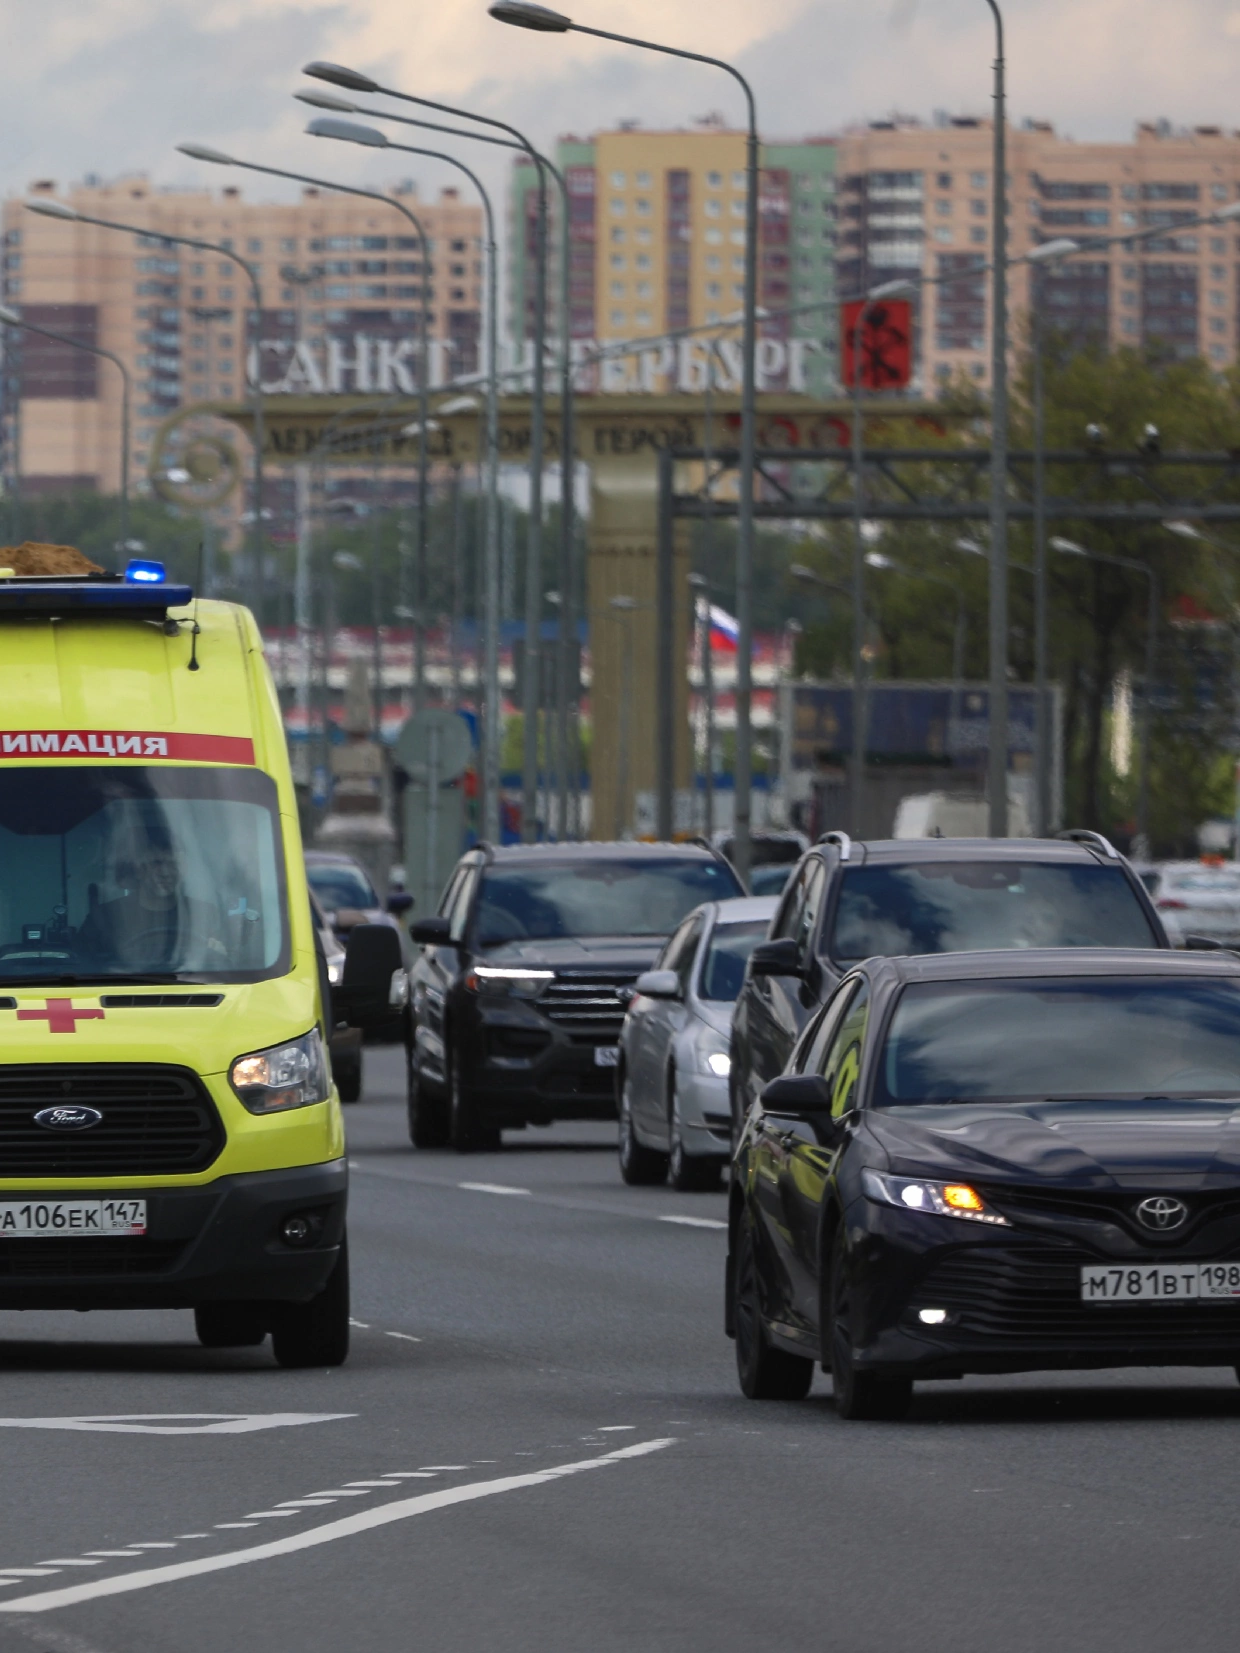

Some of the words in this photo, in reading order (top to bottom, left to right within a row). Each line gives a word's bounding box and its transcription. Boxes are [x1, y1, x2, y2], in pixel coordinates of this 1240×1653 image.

[49, 1108, 87, 1126] Ford
[104, 1202, 140, 1221] 147
[111, 1220, 131, 1228] RUS
[1201, 1266, 1240, 1287] 198
[1209, 1287, 1231, 1295] RUS
